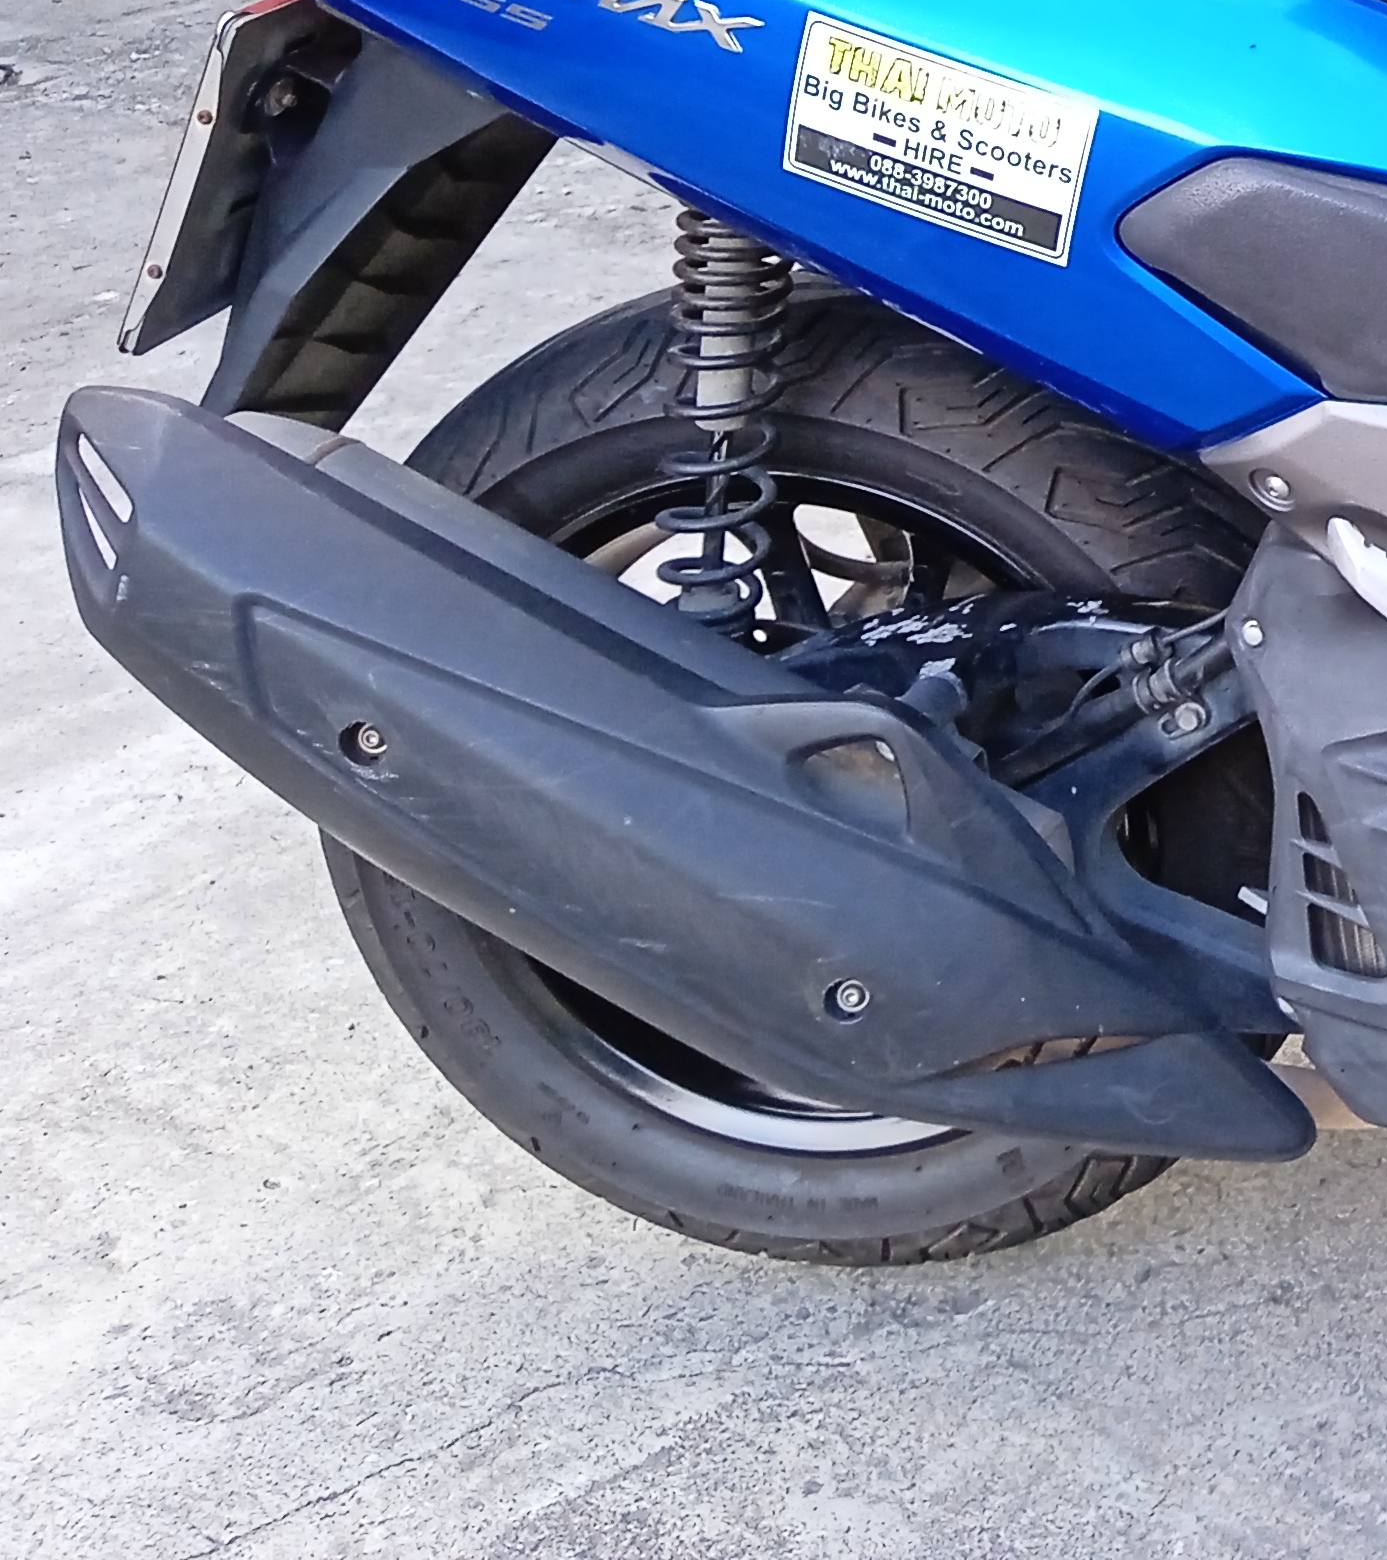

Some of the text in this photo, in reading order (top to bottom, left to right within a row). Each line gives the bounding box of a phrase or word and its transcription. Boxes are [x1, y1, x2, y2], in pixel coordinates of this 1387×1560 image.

[829, 36, 929, 104] THAI
[804, 75, 1073, 183] Big Bikes & Scooters
[936, 76, 1061, 147] MOTO
[869, 154, 992, 209] 088-3987300
[903, 139, 964, 175] HIRE
[830, 160, 1024, 236] www.thai-moto.com
